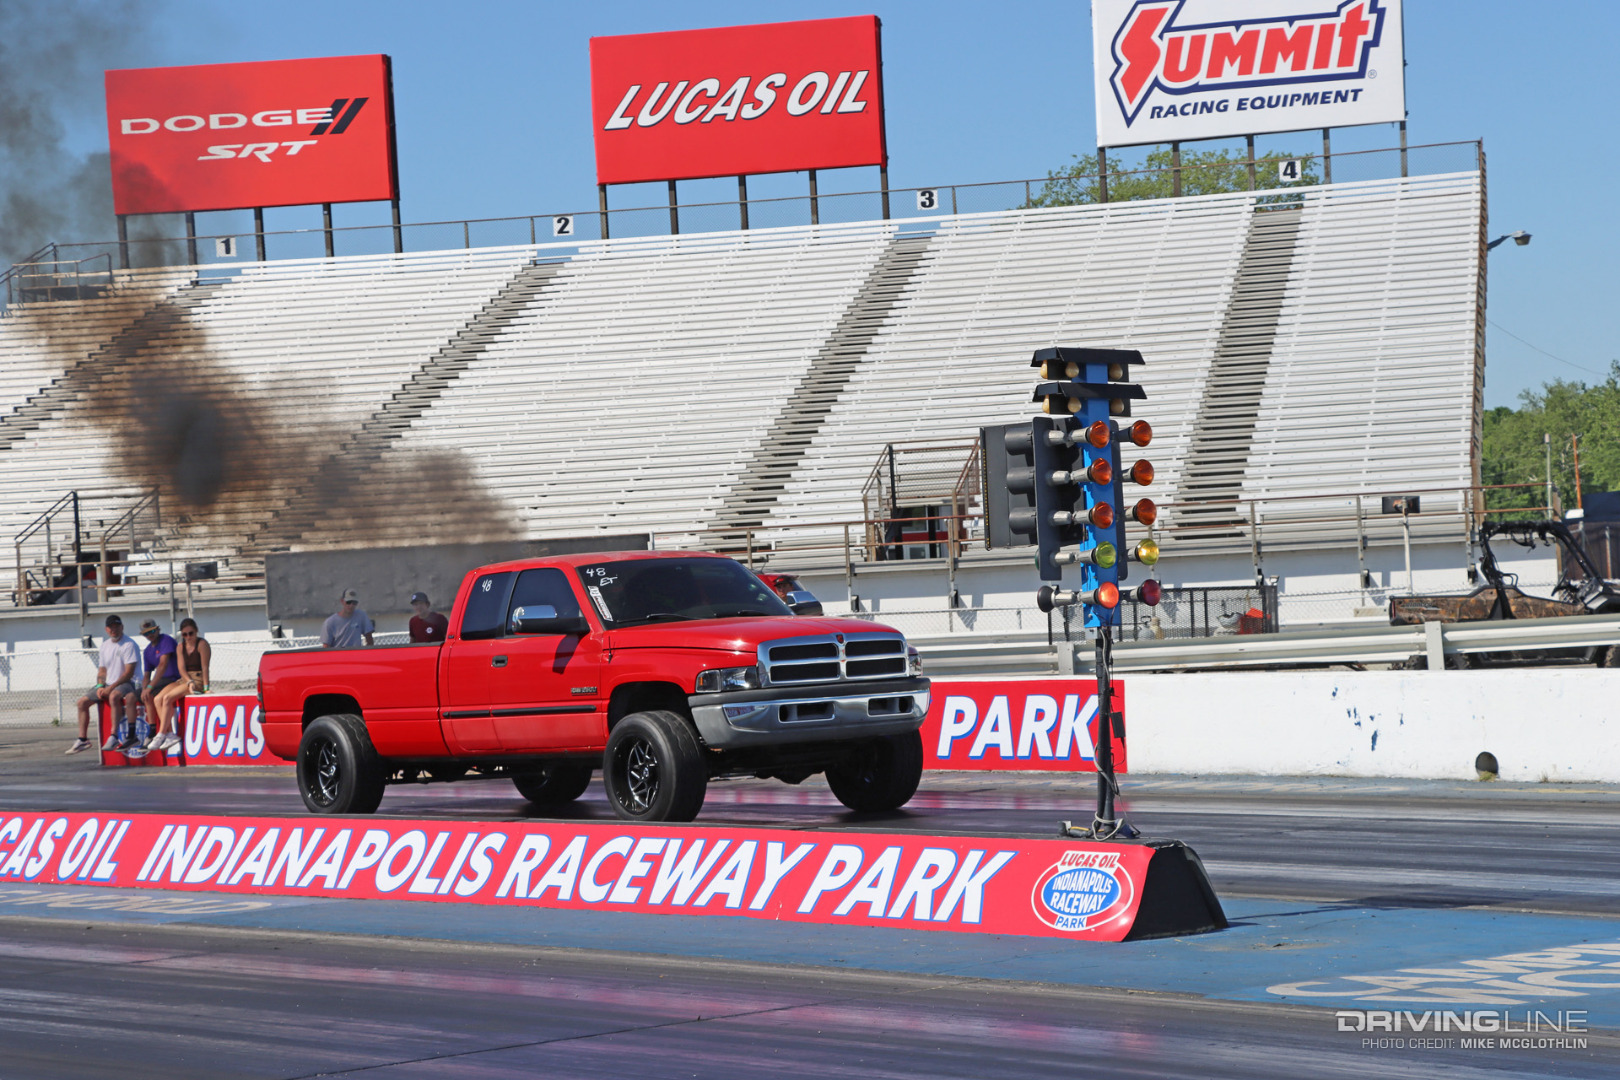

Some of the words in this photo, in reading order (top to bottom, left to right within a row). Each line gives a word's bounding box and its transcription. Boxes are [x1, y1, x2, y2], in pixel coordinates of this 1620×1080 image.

[603, 72, 788, 131] LUCAS
[786, 70, 870, 117] OIL
[1150, 99, 1229, 120] RACING
[1236, 88, 1364, 112] EQUIPMENT
[120, 107, 334, 135] DODGE
[197, 139, 319, 163] SRT
[1282, 160, 1298, 180] 4
[920, 190, 935, 209] 3
[556, 217, 571, 235] 2
[219, 238, 232, 255] 1
[585, 567, 606, 577] 48
[481, 579, 493, 593] 48
[936, 694, 1100, 761] PARK
[0, 816, 69, 882] CAS
[57, 817, 133, 882] OIL
[135, 824, 509, 897] INDIANAPOLIS
[494, 833, 819, 911] RACEWAY
[796, 843, 1020, 925] PARK
[1060, 852, 1100, 868] LUCAS
[1098, 854, 1118, 869] OIL
[1052, 870, 1114, 894] INDIANAPOLIS
[1050, 891, 1107, 914] RACEWAY
[1055, 915, 1086, 929] PARK
